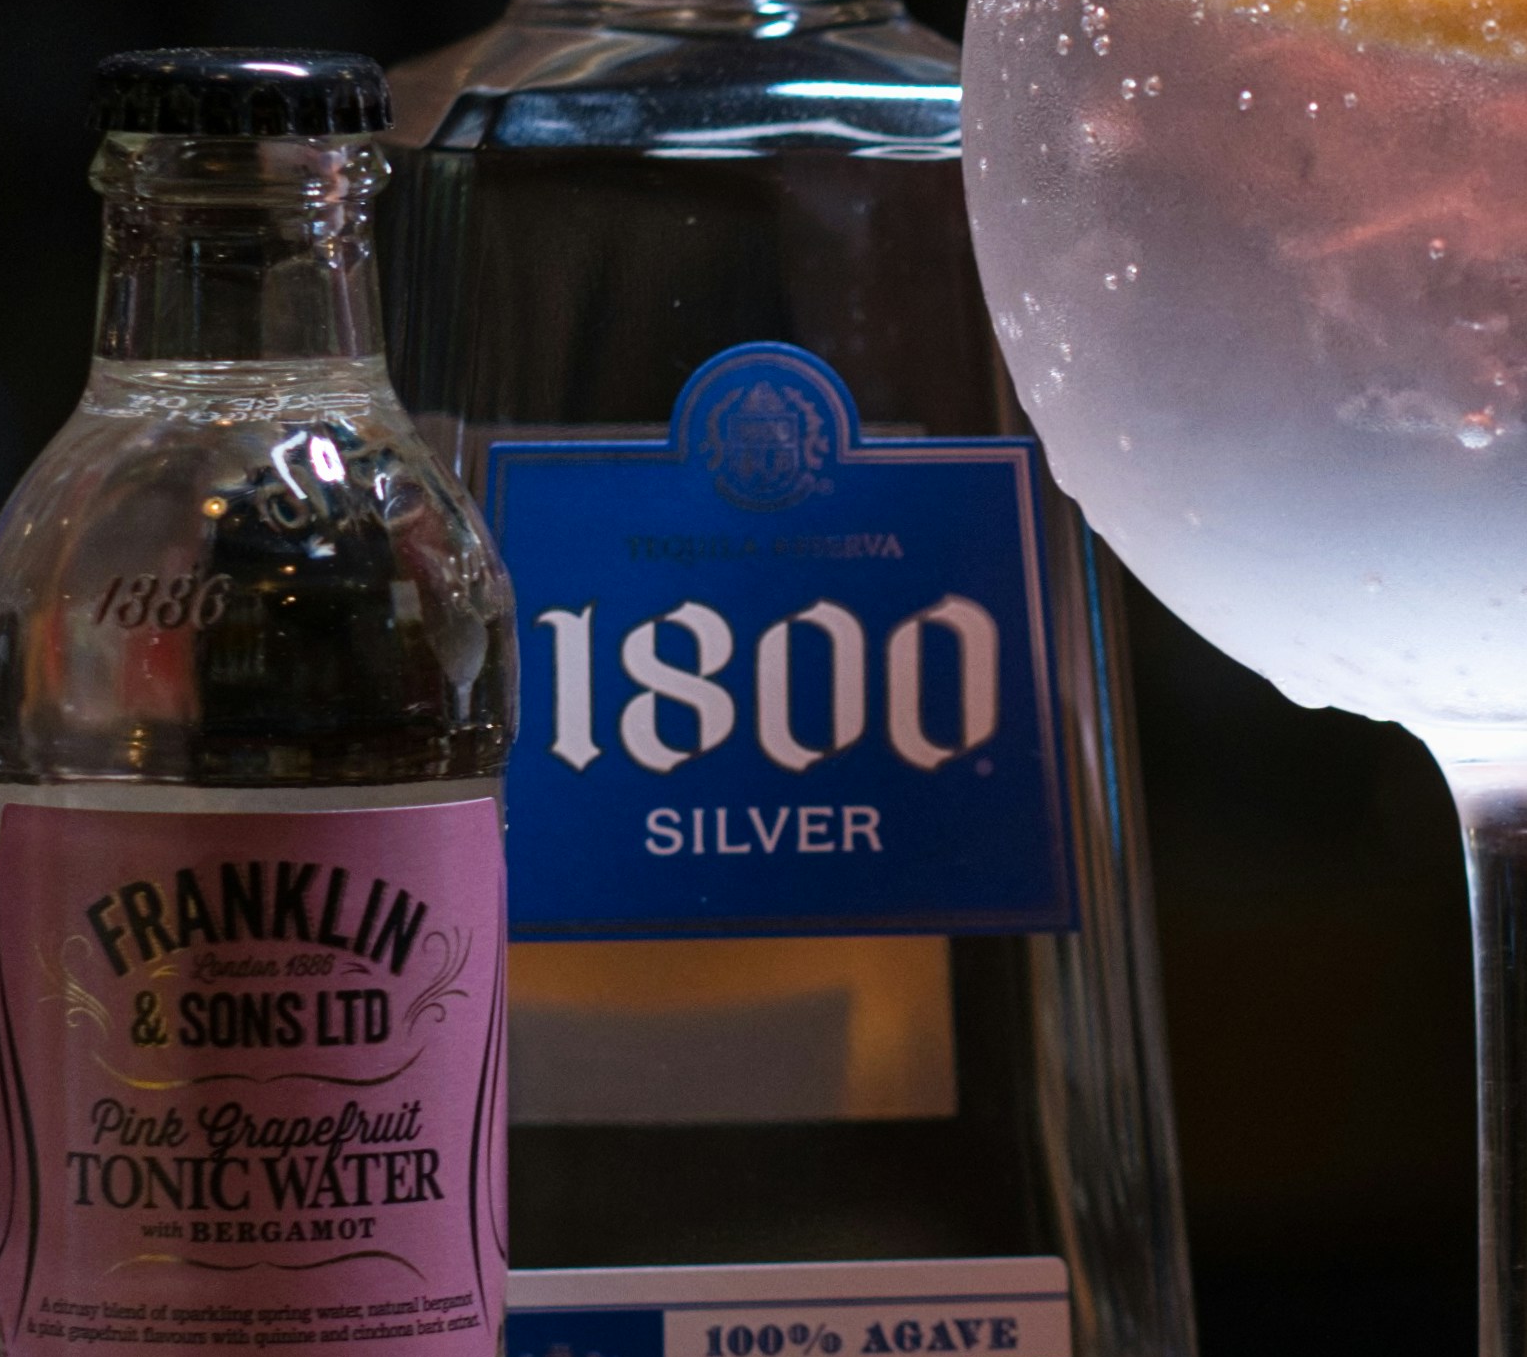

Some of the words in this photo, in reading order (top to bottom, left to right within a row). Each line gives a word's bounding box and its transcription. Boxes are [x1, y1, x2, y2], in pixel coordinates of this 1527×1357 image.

[534, 593, 1000, 775] 1800
[645, 805, 883, 856] SILVER
[86, 860, 428, 977] FRANKLIN
[190, 952, 279, 982] London
[285, 953, 336, 977] 1886
[131, 990, 166, 1047] &
[180, 990, 309, 1047] SONS
[317, 989, 391, 1045] LTD
[91, 1097, 188, 1148] Pink
[198, 1099, 422, 1175] Grapefruit
[67, 1150, 250, 1210] TONIC
[261, 1147, 444, 1210] WATER
[141, 1221, 184, 1240] with
[191, 1217, 376, 1243] BERGAMOT
[37, 1320, 65, 1338] pink
[68, 1325, 138, 1345] grapefruit
[142, 1327, 207, 1344] flavours
[212, 1329, 250, 1345] with
[254, 1327, 316, 1349] quinine
[320, 1325, 349, 1343] and
[353, 1322, 414, 1341] cinchona
[416, 1318, 445, 1335] bark
[103, 1302, 146, 1320] blend
[150, 1304, 168, 1320] of
[171, 1305, 253, 1325] sparkling
[258, 1305, 311, 1324] spring
[316, 1304, 363, 1321] water,
[368, 1297, 419, 1318] natural
[704, 1322, 843, 1357] 100%
[860, 1317, 1019, 1355] AGAVE
